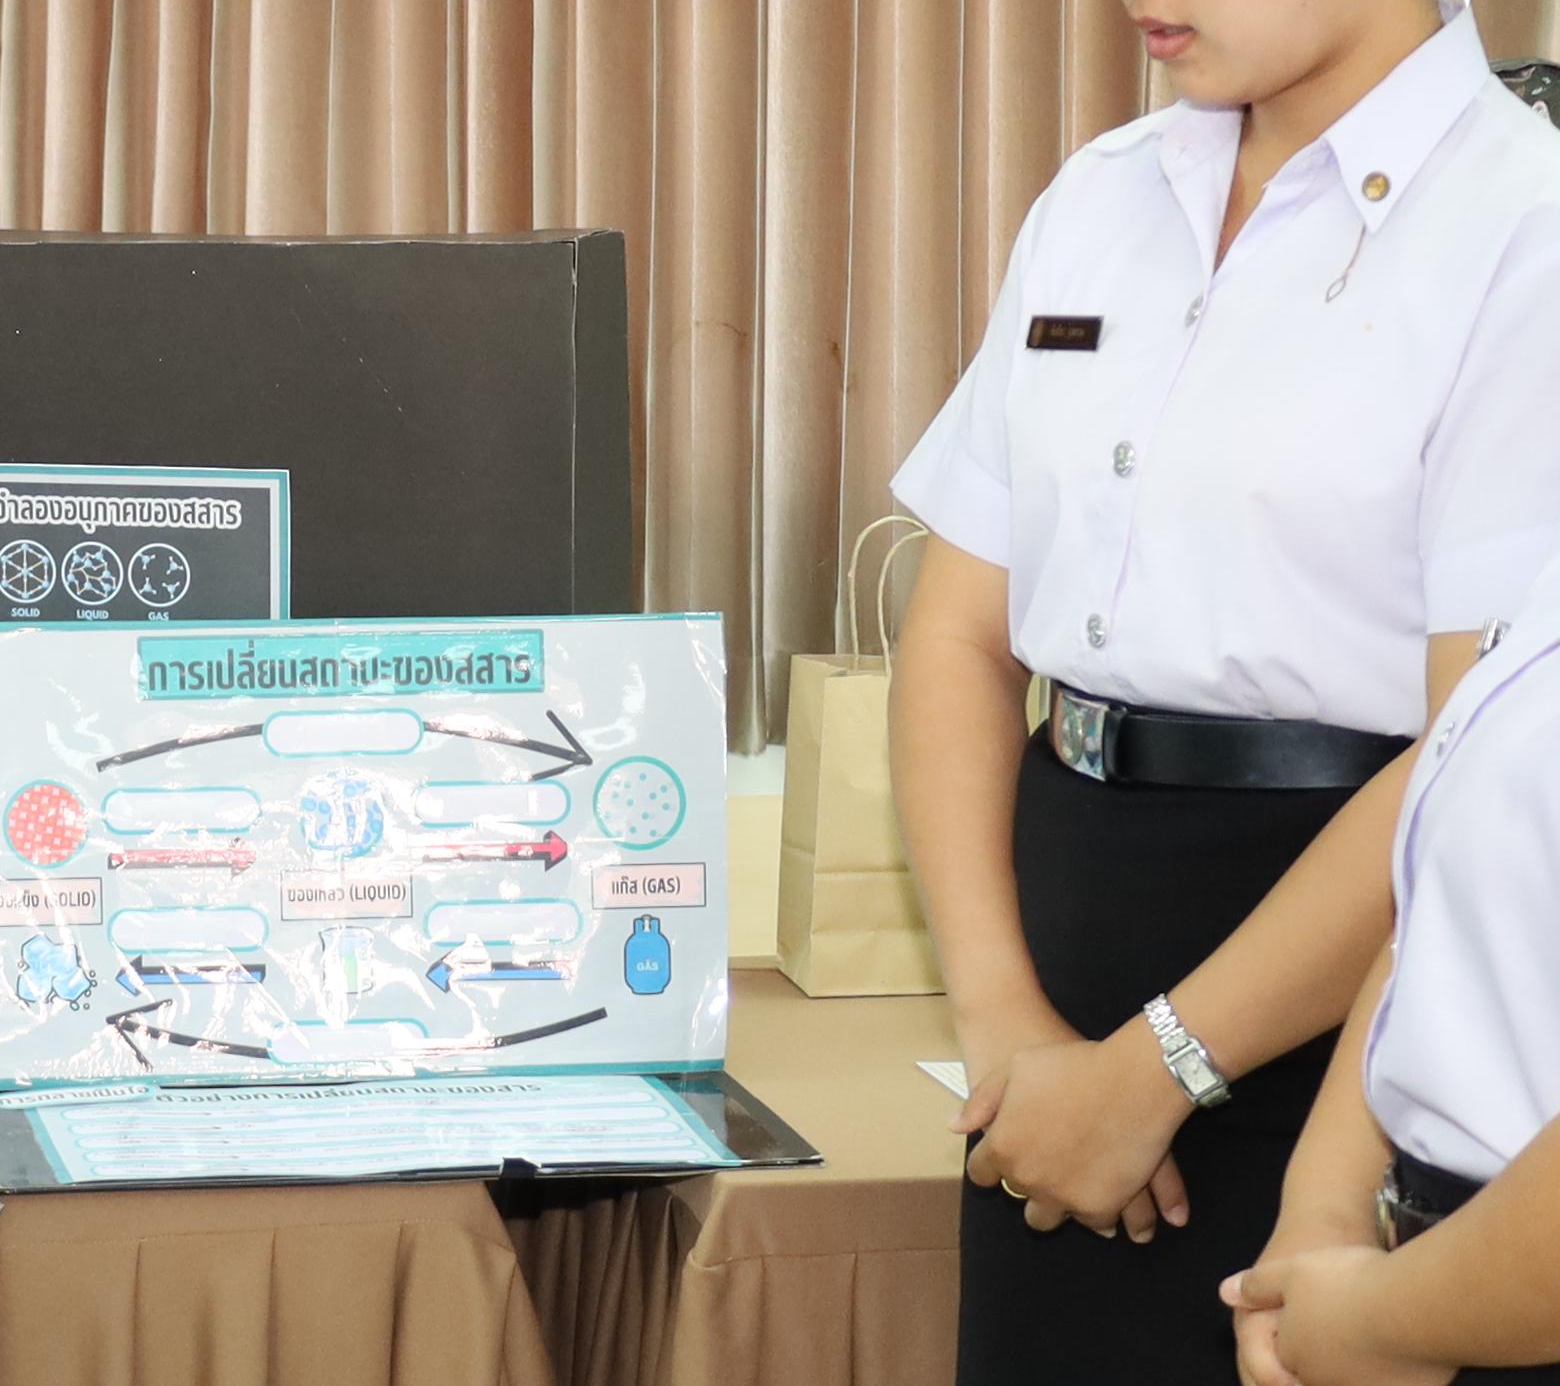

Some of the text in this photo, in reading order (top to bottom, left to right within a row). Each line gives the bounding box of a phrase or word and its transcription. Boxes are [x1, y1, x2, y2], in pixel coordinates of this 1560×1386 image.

[11, 607, 40, 618] SOLID
[76, 609, 109, 621] LIQUID
[147, 611, 170, 621] GAS
[148, 639, 531, 692] การเปลี่ยนสถานะของสสาร
[287, 883, 407, 903] ของเหลว (LIQUID)
[611, 875, 681, 896] แก๊ส (GAS)
[44, 889, 97, 910] (OLID)
